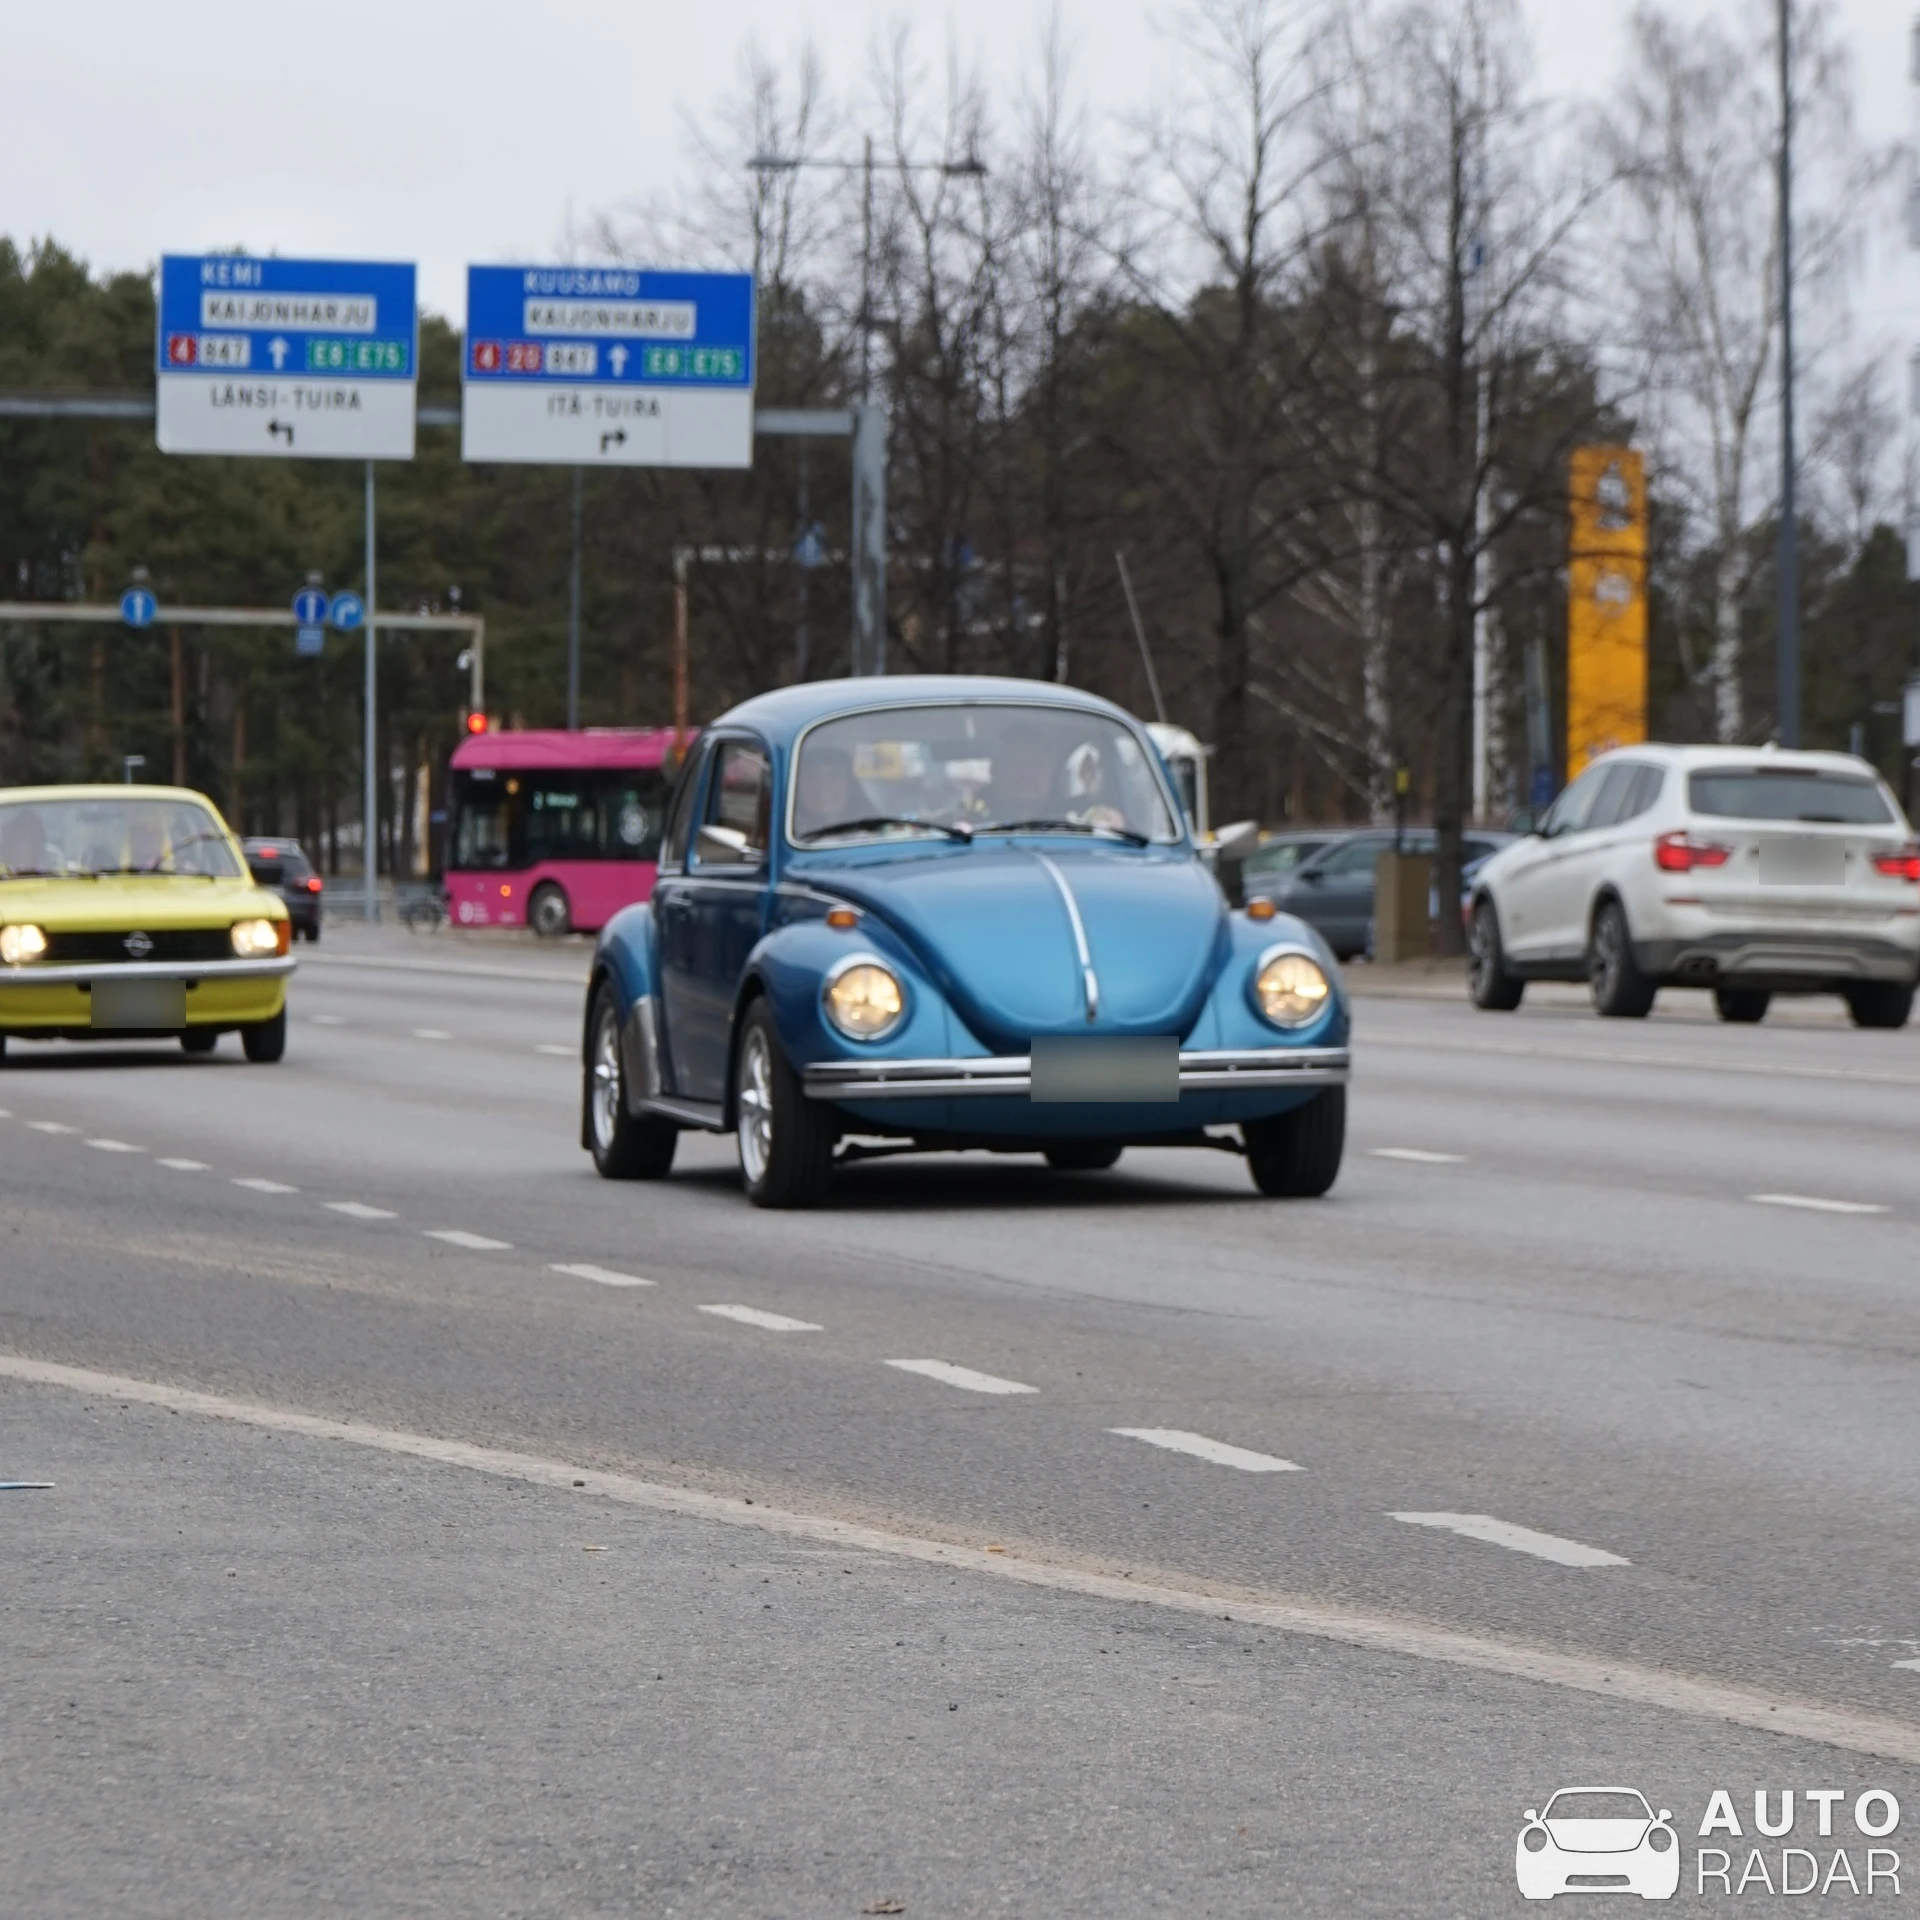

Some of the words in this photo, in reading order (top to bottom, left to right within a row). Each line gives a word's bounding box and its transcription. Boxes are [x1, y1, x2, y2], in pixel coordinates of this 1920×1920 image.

[201, 264, 262, 286] KEMI
[525, 271, 640, 295] KUUSAMO
[208, 299, 370, 326] KAIJONHARJU
[530, 306, 690, 334] KAIJONHARJU
[175, 340, 190, 363] 4
[315, 346, 344, 369] E8
[357, 347, 401, 369] E75
[480, 347, 496, 369] 4
[508, 346, 540, 371] 20
[652, 350, 681, 374] E8
[693, 352, 737, 375] E75
[211, 384, 362, 411] LÄNSI-TUIRA
[547, 393, 660, 418] ITÄ-TUIRA
